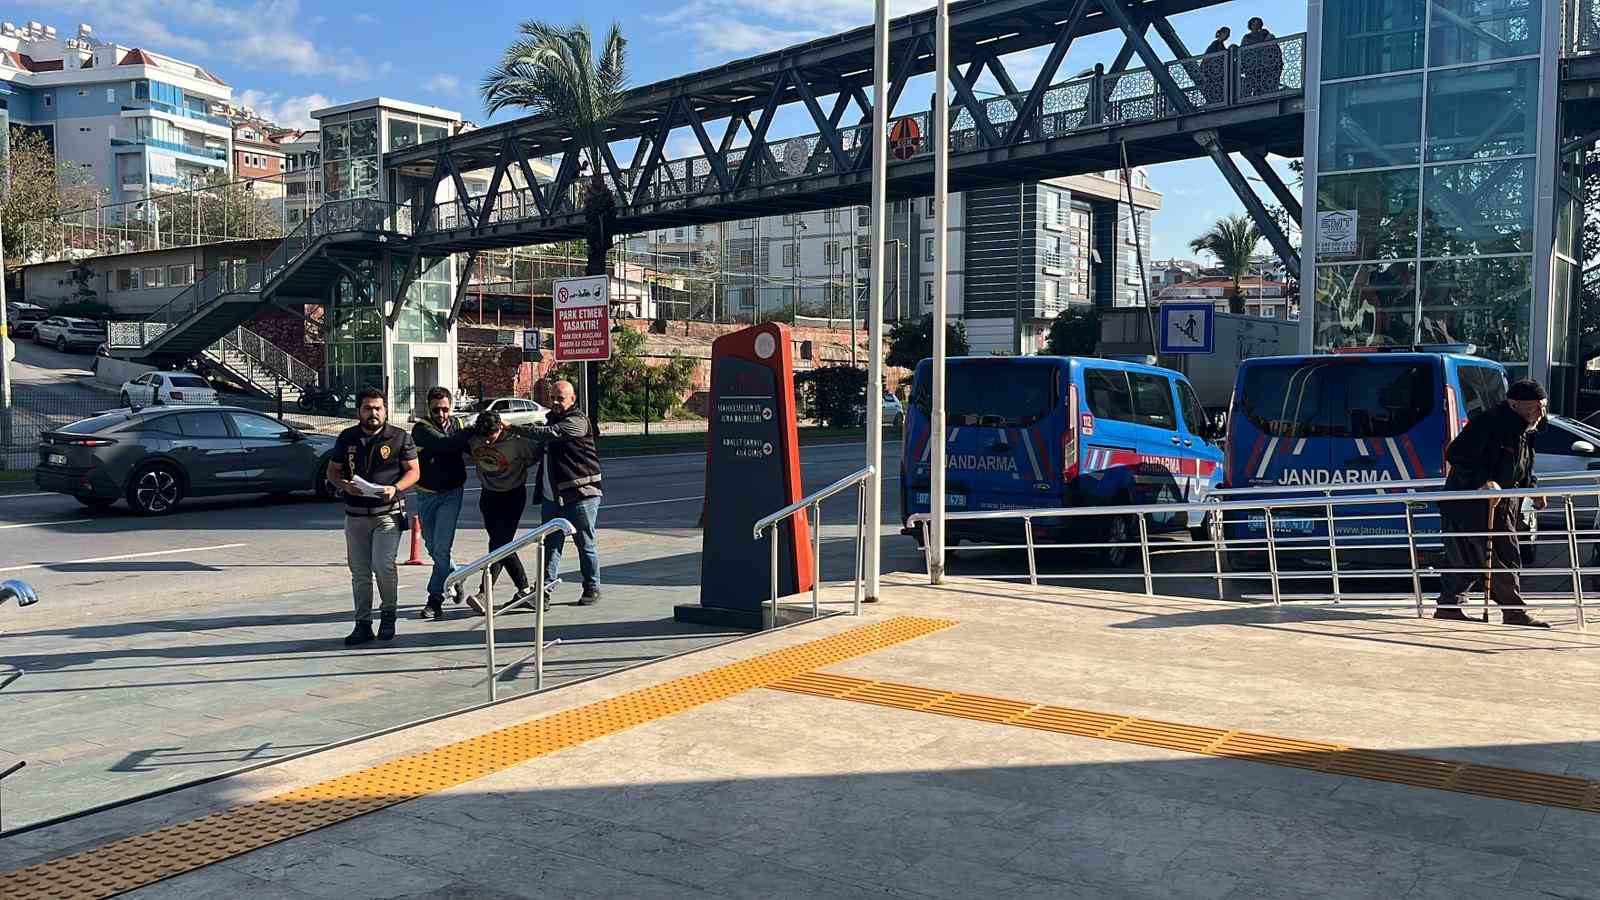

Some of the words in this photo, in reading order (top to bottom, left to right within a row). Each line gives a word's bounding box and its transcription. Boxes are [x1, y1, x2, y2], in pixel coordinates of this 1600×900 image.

[559, 310, 577, 320] PARK
[578, 308, 603, 319] ETMEK
[563, 320, 599, 331] YASAKTIR!
[944, 455, 1018, 473] JANDARMA
[1142, 455, 1180, 474] JANDARMA
[1278, 468, 1392, 486] JANDARMA
